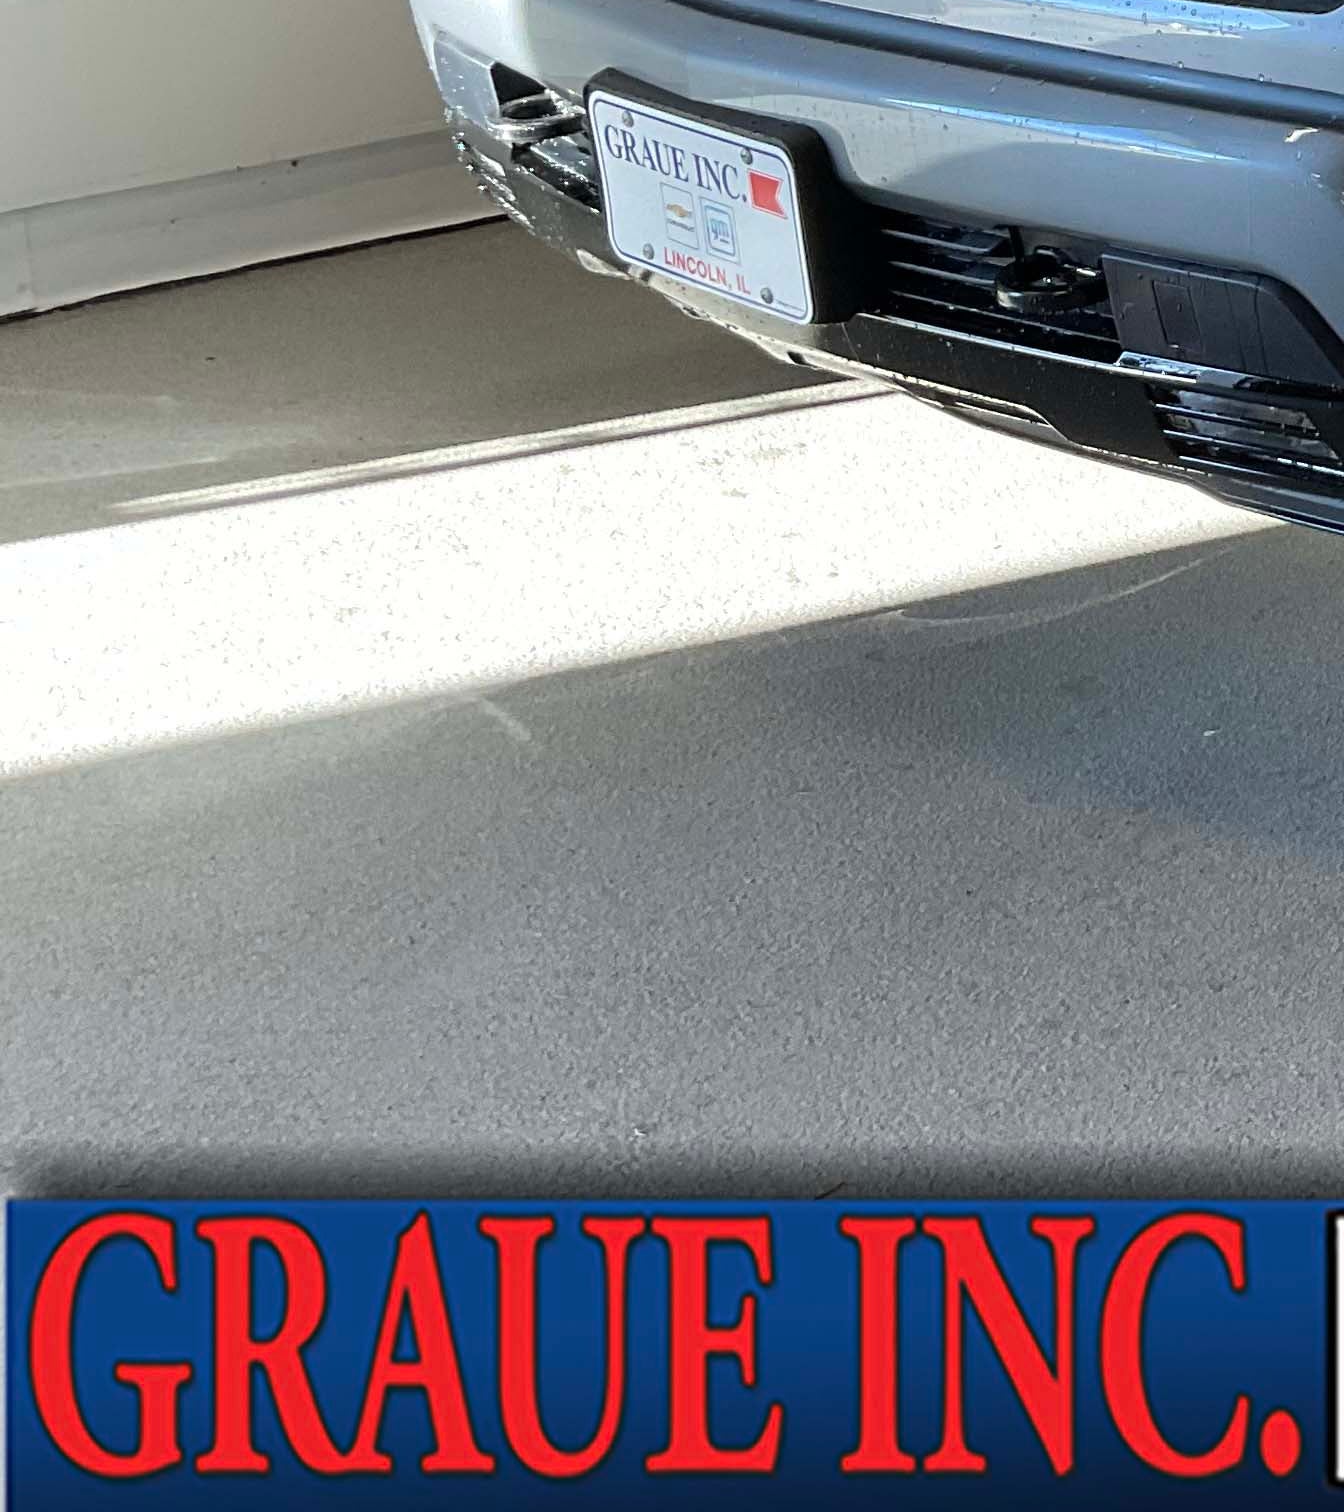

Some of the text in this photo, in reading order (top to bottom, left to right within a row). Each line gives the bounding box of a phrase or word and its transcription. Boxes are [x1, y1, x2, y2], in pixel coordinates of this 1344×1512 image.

[604, 124, 747, 202] GRAUE INC.
[663, 246, 752, 296] LINCOLN, IL
